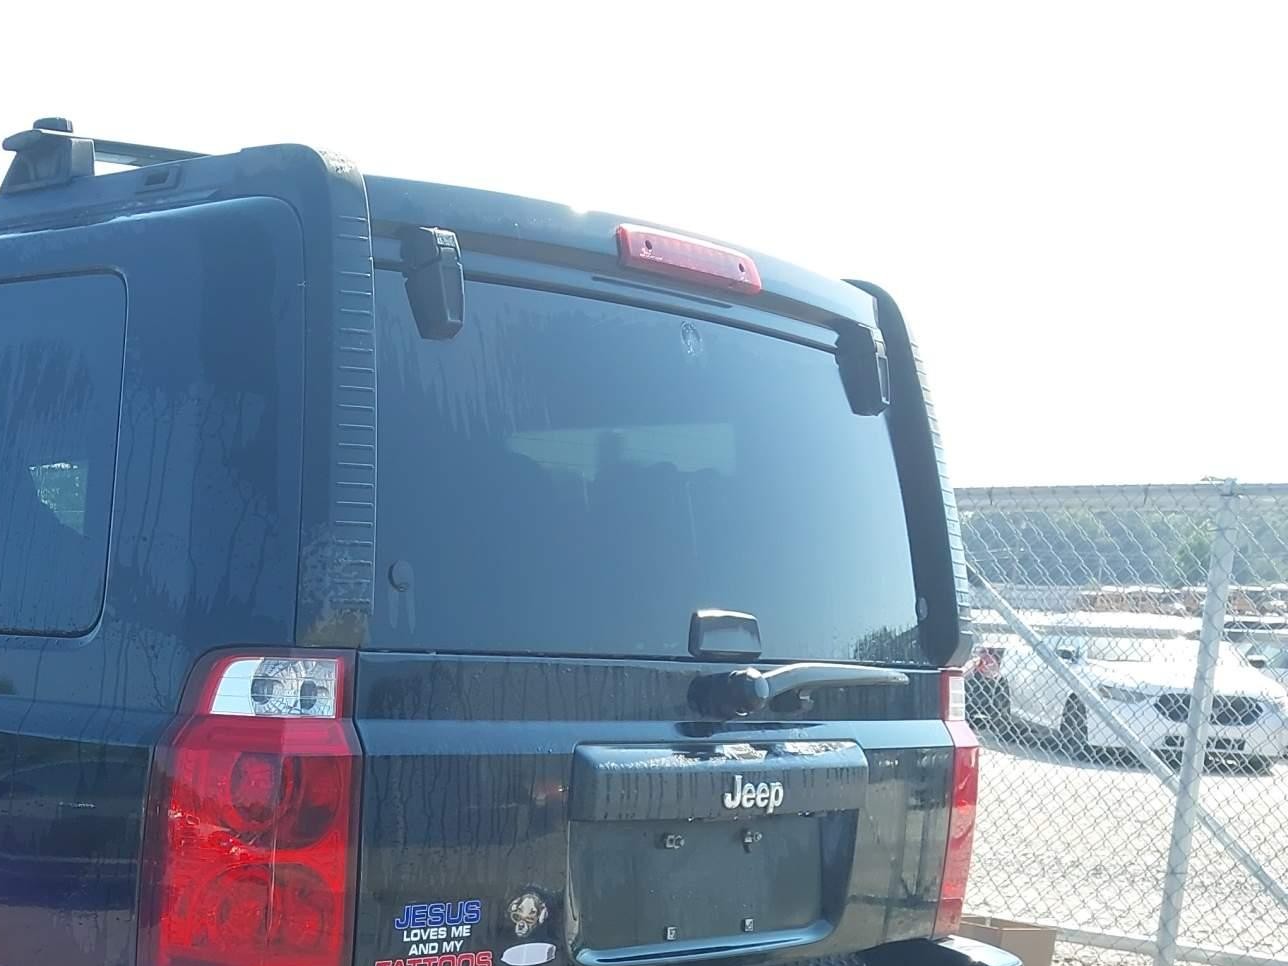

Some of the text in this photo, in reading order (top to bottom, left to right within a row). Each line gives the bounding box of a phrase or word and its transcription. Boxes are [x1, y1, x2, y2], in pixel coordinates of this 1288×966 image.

[723, 774, 784, 815] Jeep
[394, 900, 482, 930] JESUS
[403, 924, 472, 942] LOVES ME
[408, 939, 464, 956] AND MY
